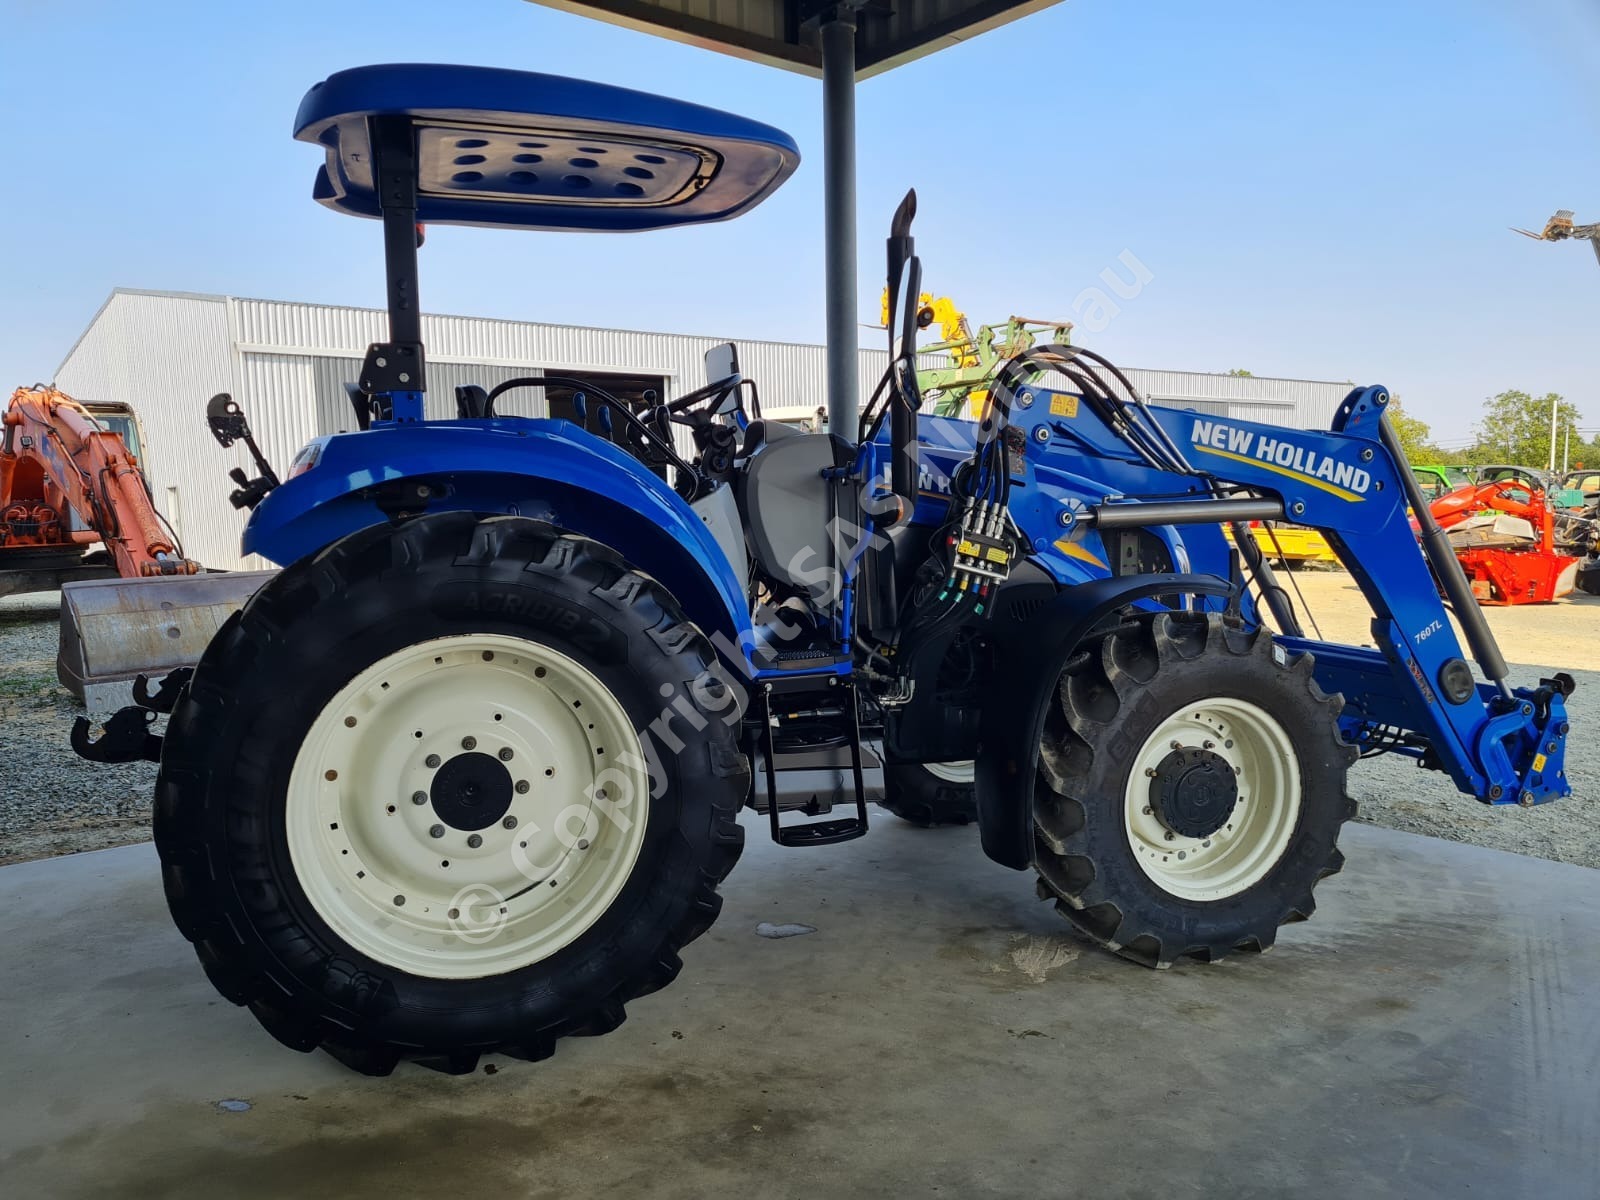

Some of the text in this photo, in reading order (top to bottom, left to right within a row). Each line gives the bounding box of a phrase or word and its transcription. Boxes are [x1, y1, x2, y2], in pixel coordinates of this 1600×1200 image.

[1191, 419, 1371, 494] NEW HOLLAND
[1414, 620, 1443, 645] 760TL
